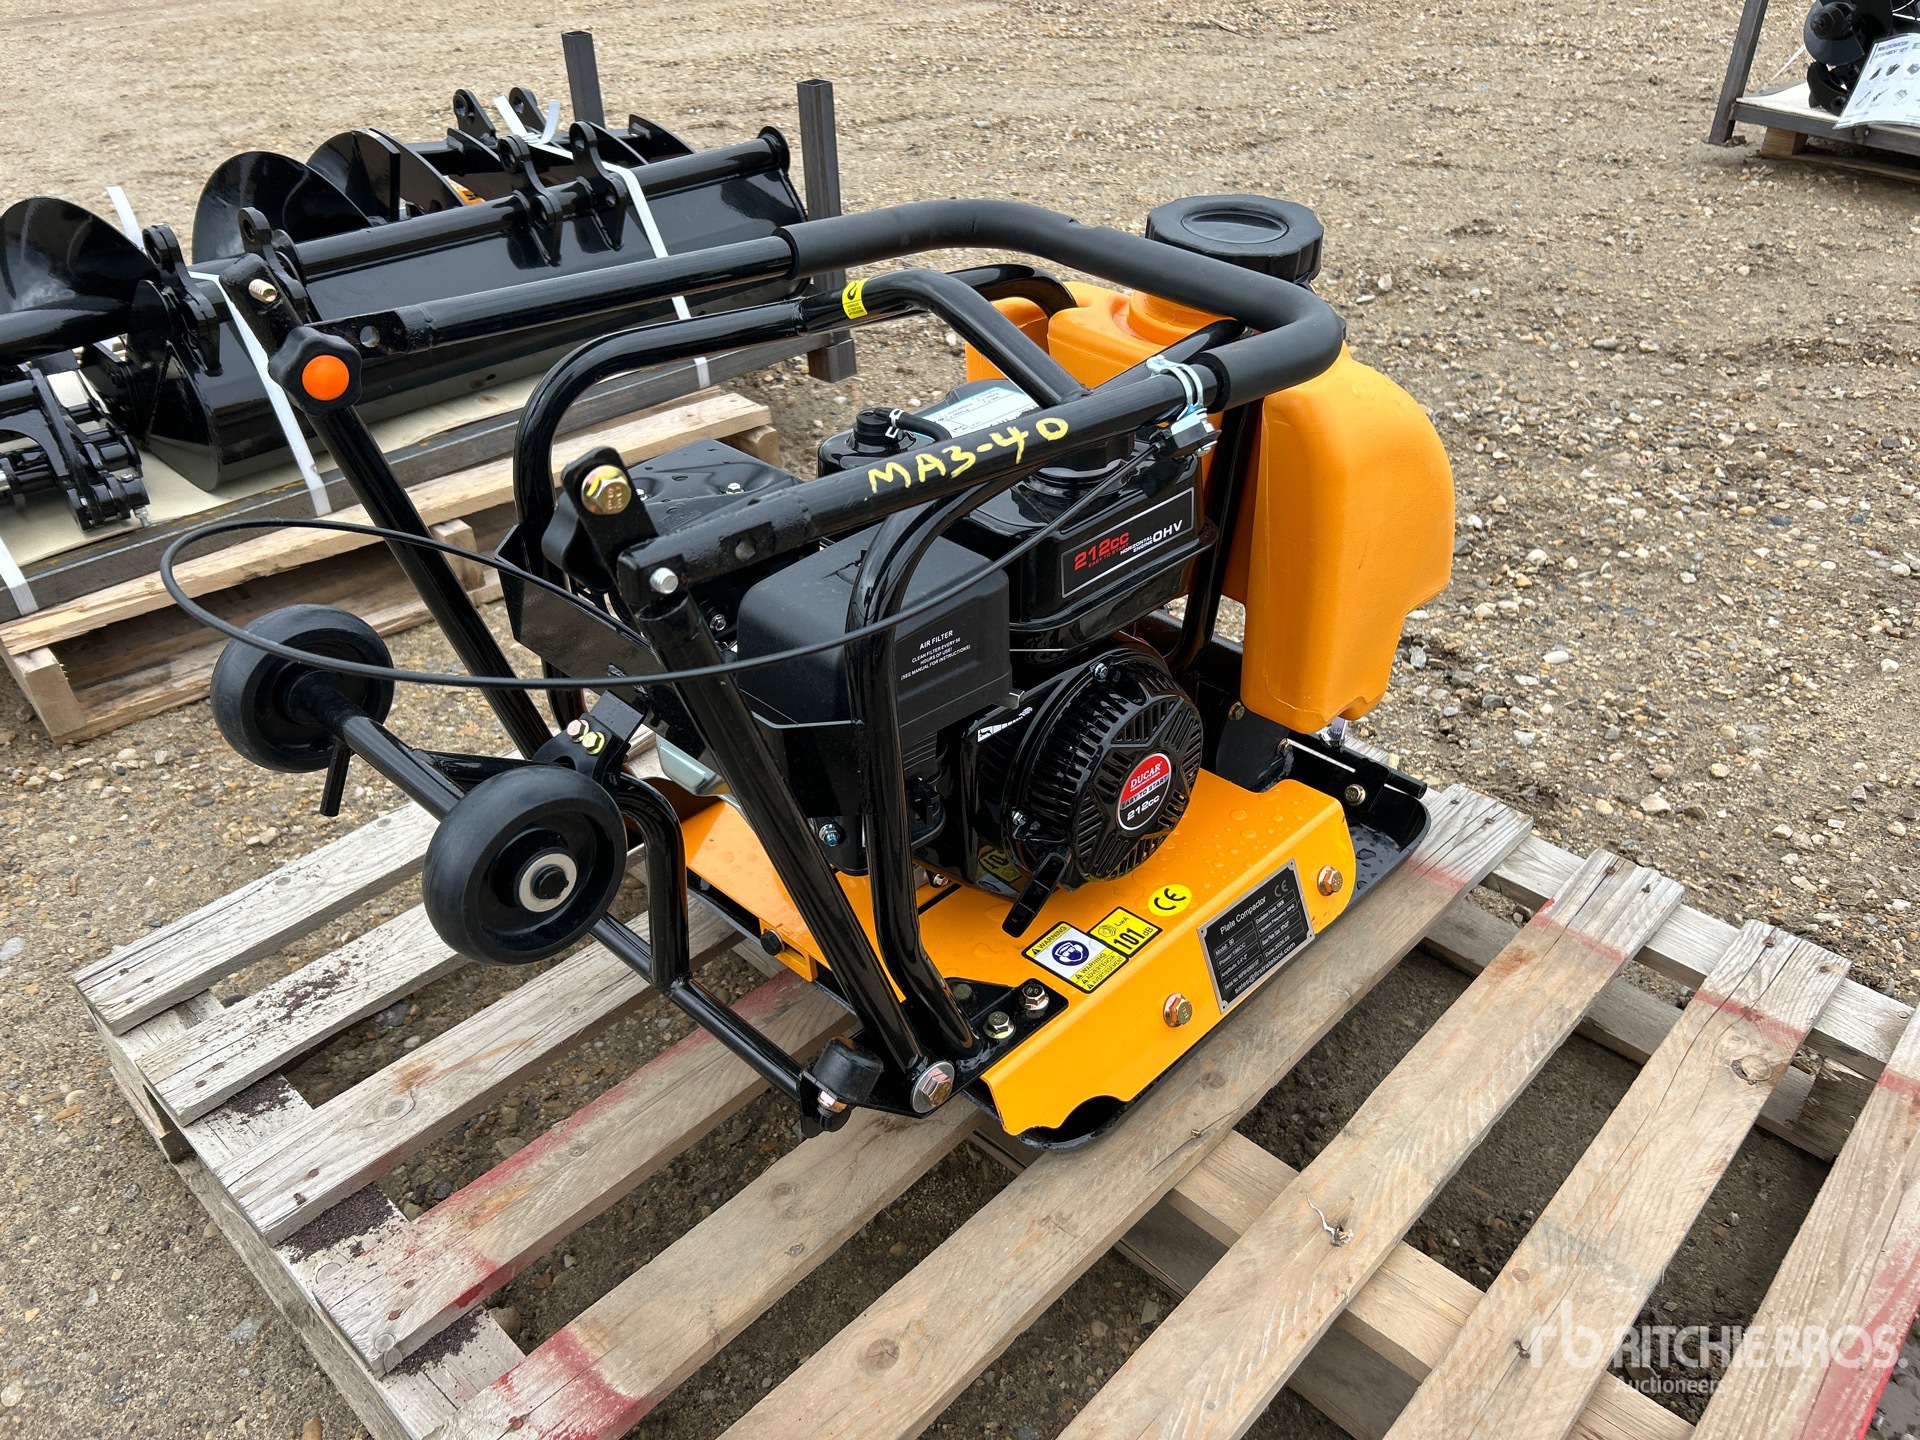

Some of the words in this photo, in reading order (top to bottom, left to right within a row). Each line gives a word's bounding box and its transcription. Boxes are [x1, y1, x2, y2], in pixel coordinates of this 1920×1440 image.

[868, 417, 1069, 494] MA3-40
[1119, 535, 1153, 556] HORIZONTAL
[1152, 519, 1183, 543] OHV
[1133, 540, 1154, 553] ENGINE
[1074, 532, 1130, 571] 212cc
[911, 652, 926, 663] CLEAN
[926, 646, 941, 656] FILTER
[940, 639, 955, 650] EVERY
[919, 639, 931, 650] AIR
[931, 629, 954, 645] FILTER
[911, 663, 929, 675] MANUAL
[929, 659, 939, 667] FOR
[920, 654, 936, 665] HOURS
[1130, 763, 1161, 789] DUCAR
[1127, 795, 1160, 821] 212cc
[1220, 920, 1236, 935] Plate
[1235, 896, 1267, 923] Compactor
[1038, 925, 1067, 949] WARNING
[1113, 927, 1146, 951] 101
[1142, 926, 1154, 937] dB
[1081, 952, 1107, 974] WARNING
[1086, 955, 1116, 980] ADVERTENCIA
